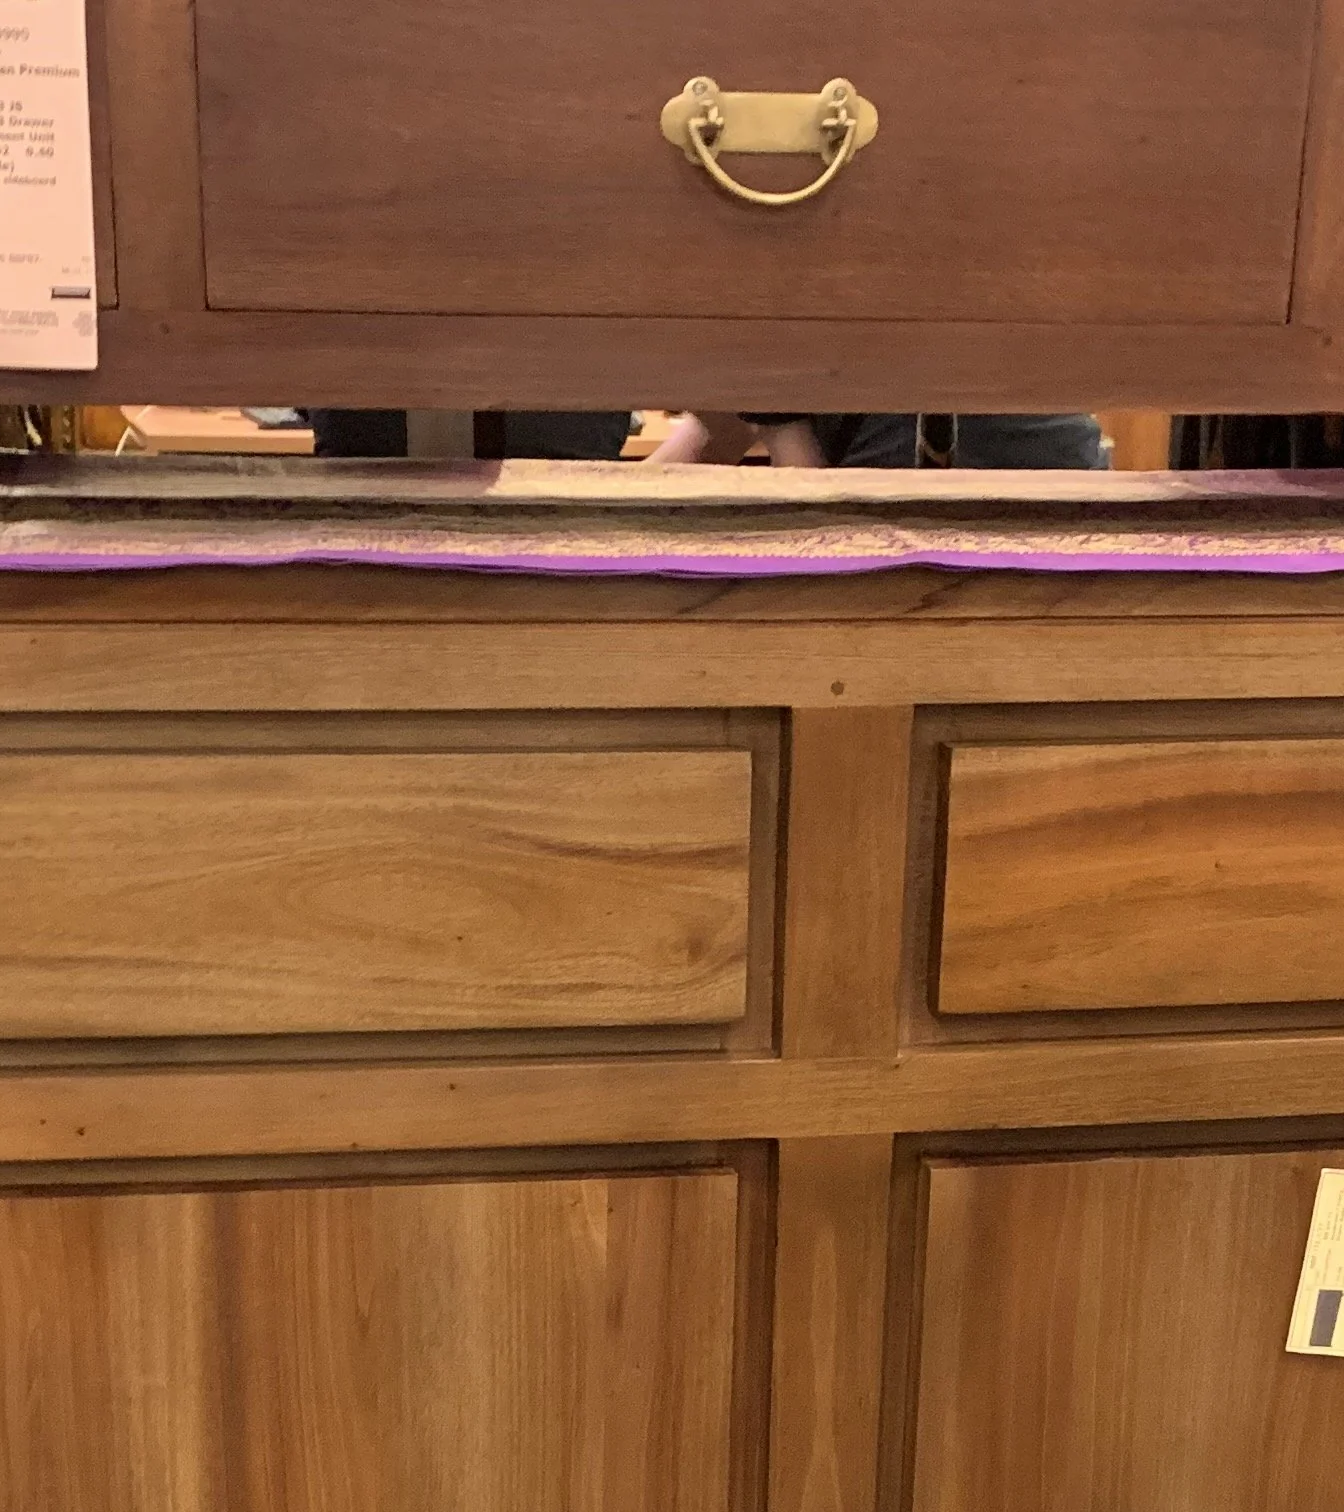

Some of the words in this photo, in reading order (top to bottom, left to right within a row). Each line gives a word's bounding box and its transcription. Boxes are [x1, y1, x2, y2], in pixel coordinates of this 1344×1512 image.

[19, 63, 80, 78] Premium
[9, 115, 54, 128] Drawer
[29, 131, 54, 143] Unit
